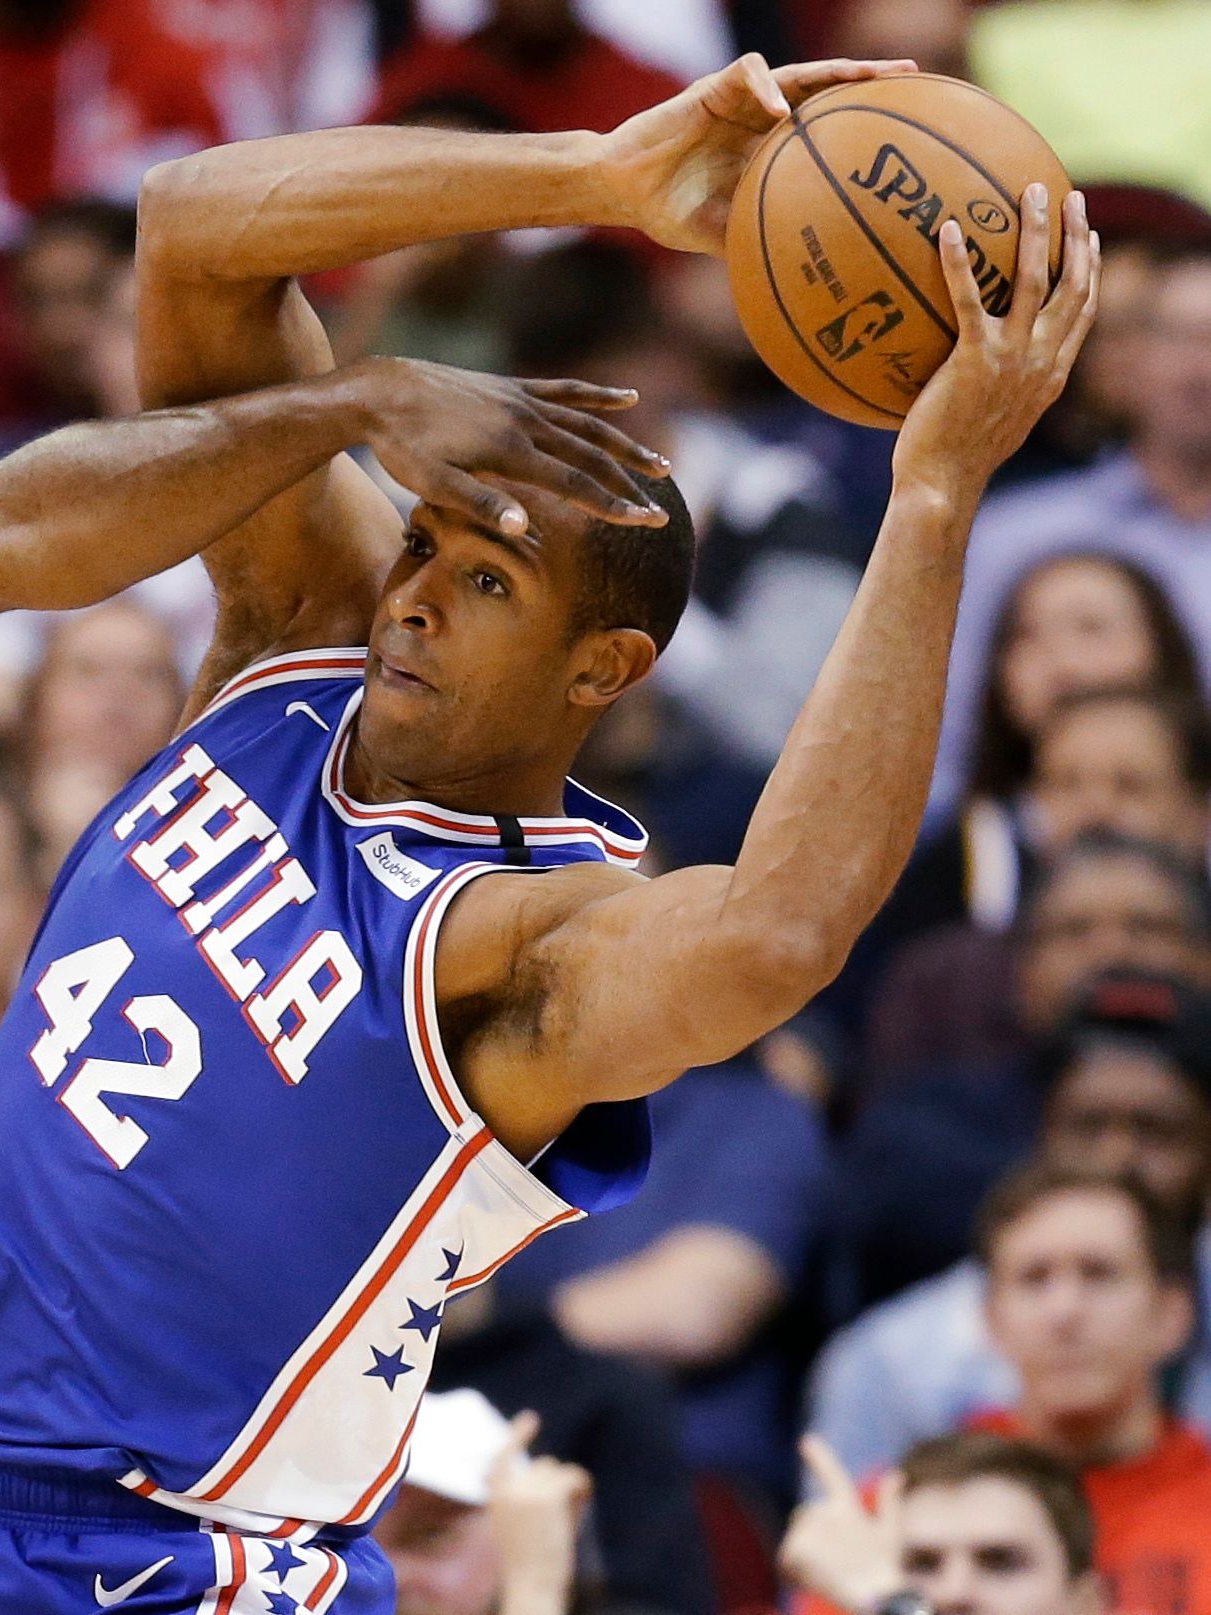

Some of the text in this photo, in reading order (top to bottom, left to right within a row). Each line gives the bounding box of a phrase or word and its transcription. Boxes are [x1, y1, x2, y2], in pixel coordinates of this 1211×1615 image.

[848, 142, 1012, 318] SPADIN
[372, 843, 422, 888] StubHub
[27, 935, 204, 1171] 42
